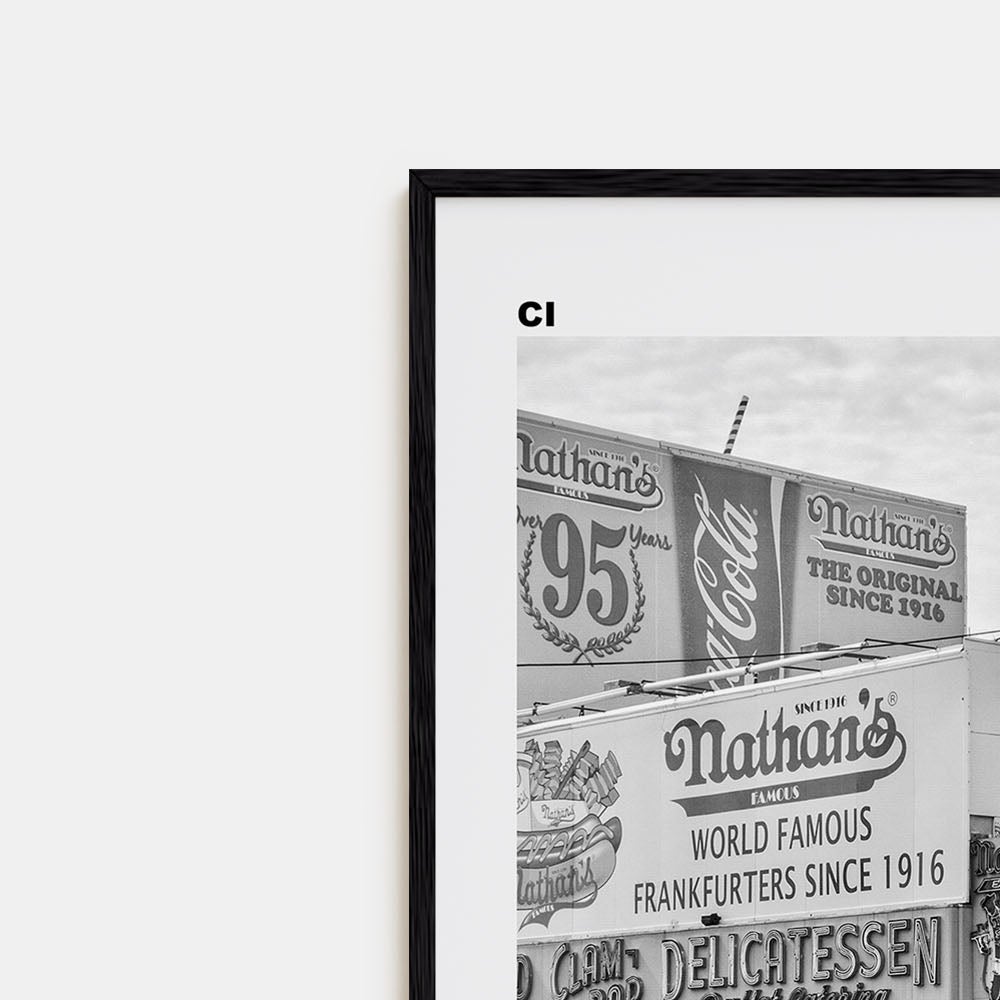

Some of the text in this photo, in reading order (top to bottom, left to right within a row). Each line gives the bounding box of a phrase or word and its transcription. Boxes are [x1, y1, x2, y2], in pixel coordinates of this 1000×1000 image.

[517, 301, 555, 328] CI
[629, 523, 673, 551] Years
[806, 494, 952, 556] Nathan's
[540, 512, 630, 627] 95
[806, 556, 963, 603] THE ORIGINAL
[825, 584, 945, 623] SINCE 1916
[794, 700, 824, 715] SINCE
[663, 687, 897, 787] Nathan's
[750, 784, 800, 806] FAMOUS
[690, 805, 873, 861] WORLD FAMOUS
[634, 849, 945, 914] FRANKFURTERS SINCE 1916
